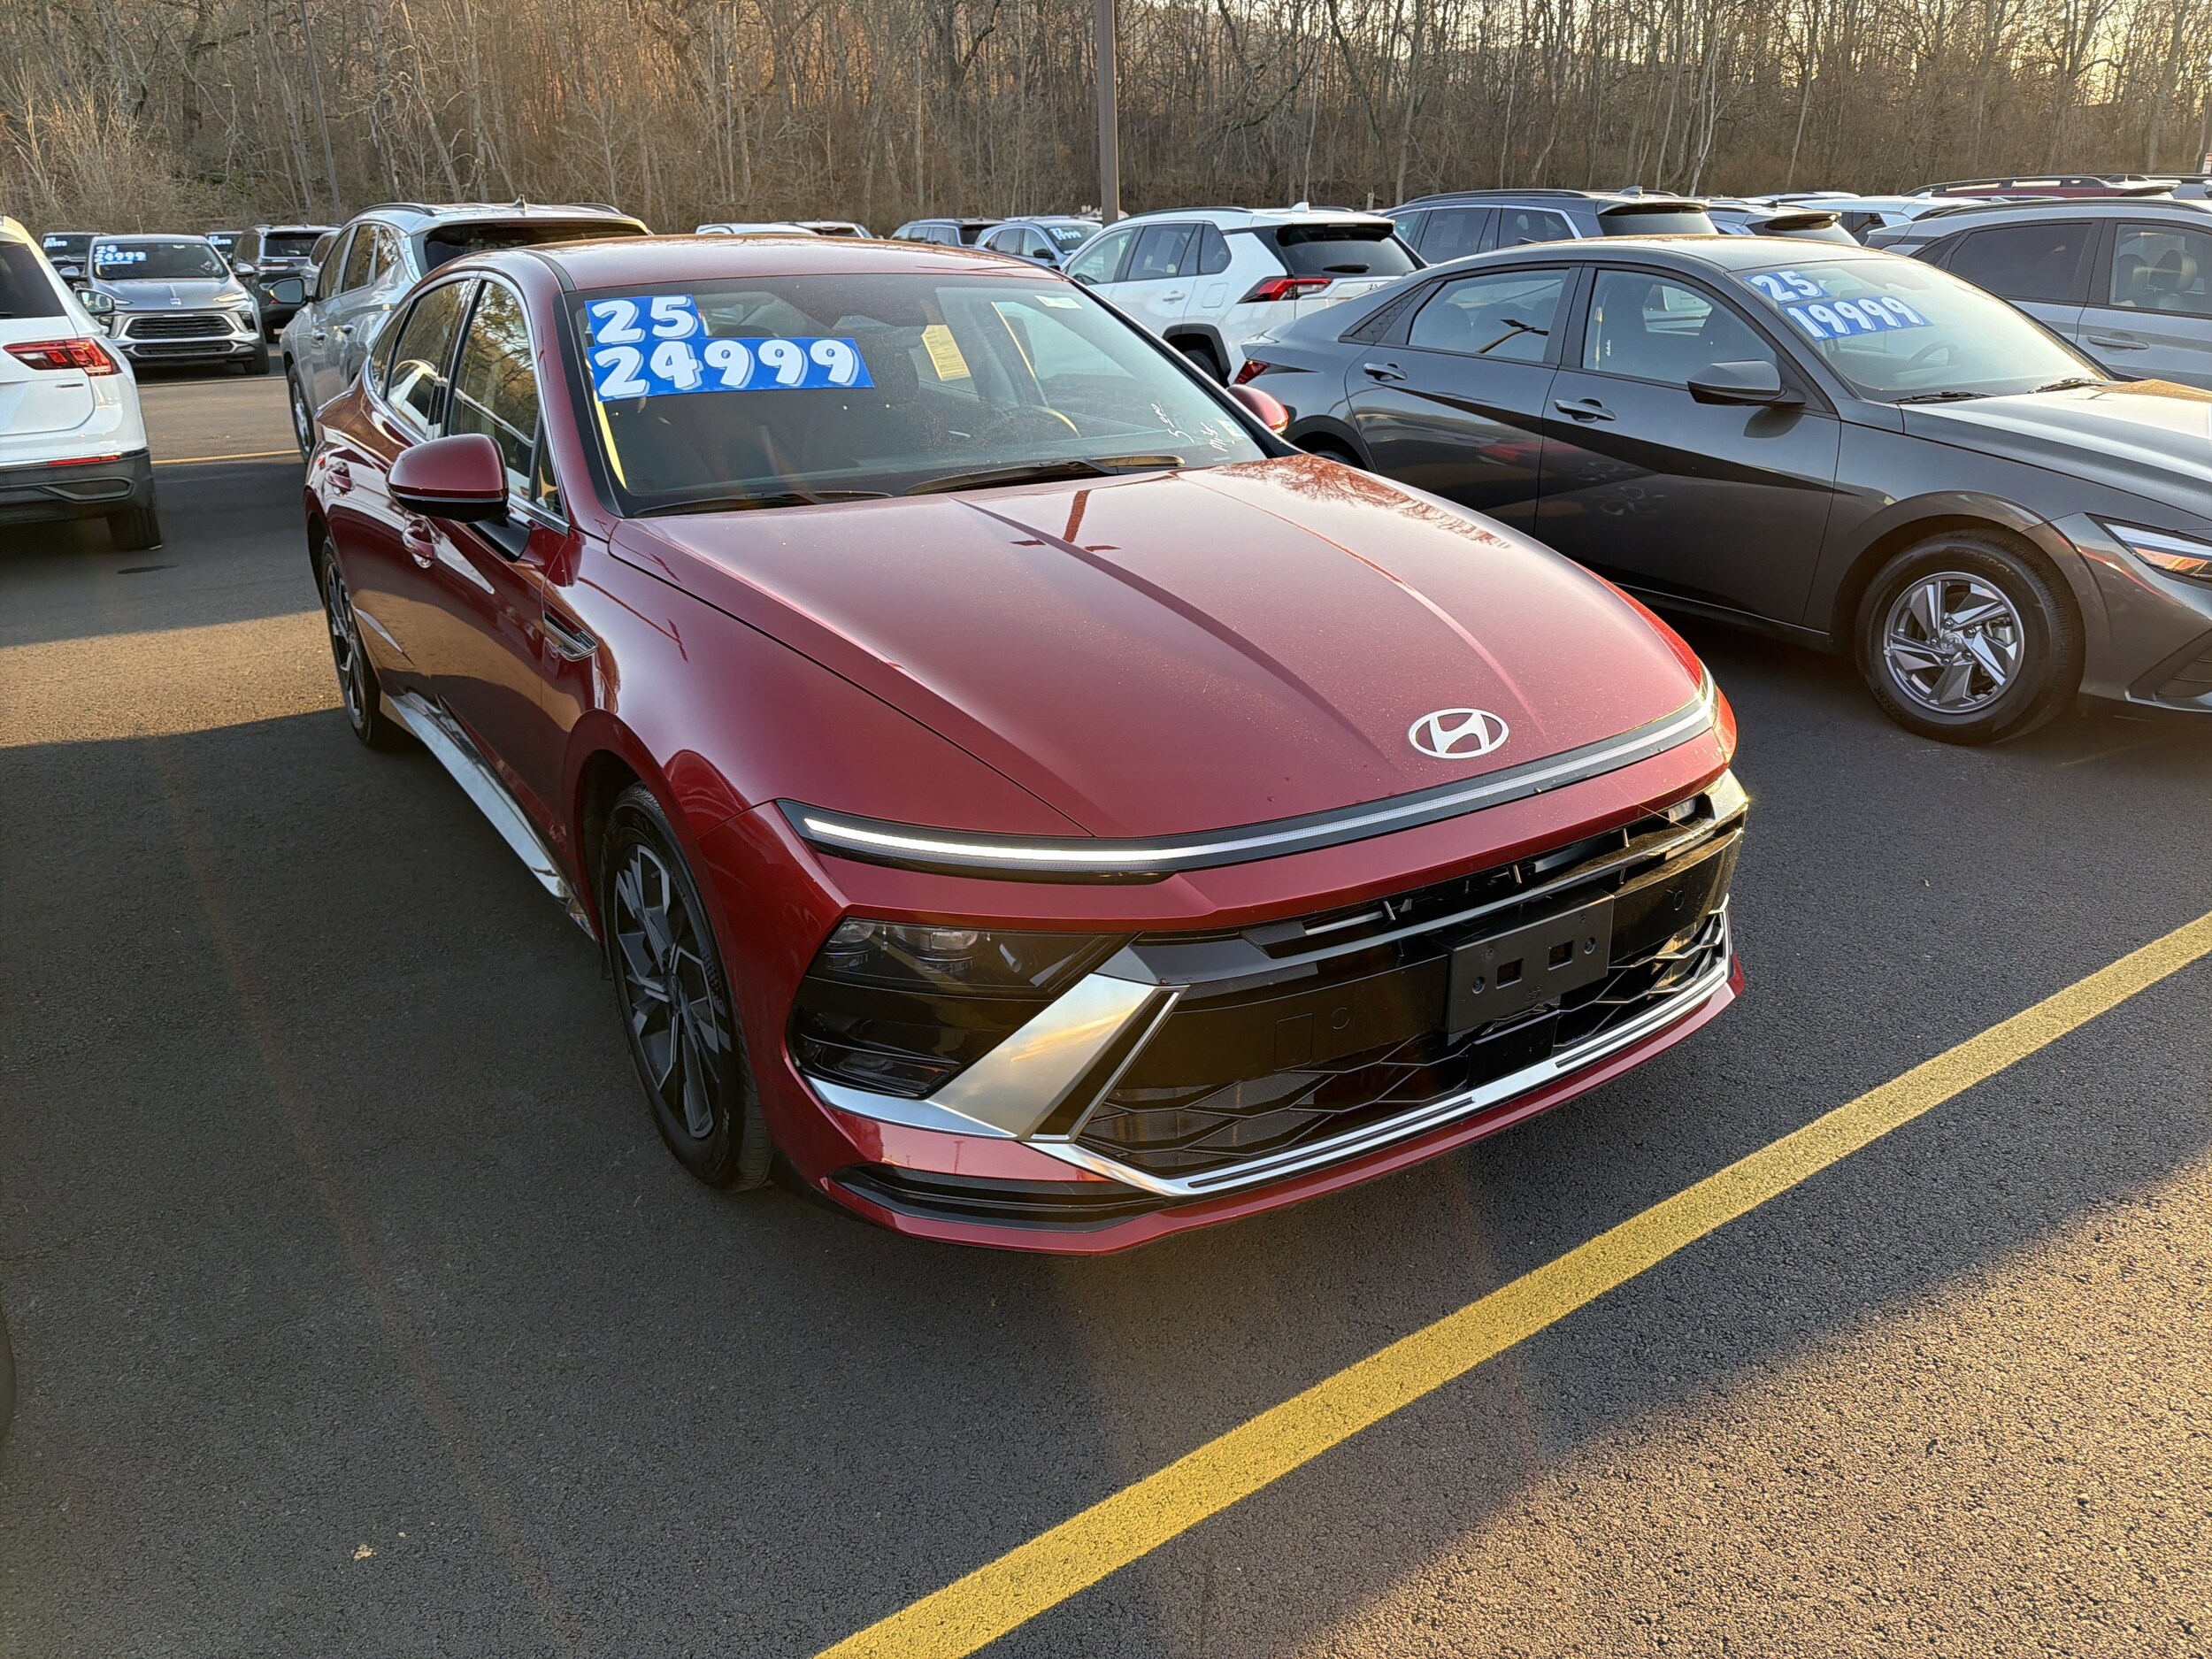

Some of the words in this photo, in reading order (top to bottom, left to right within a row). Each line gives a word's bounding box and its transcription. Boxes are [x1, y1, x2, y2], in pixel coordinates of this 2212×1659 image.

[1750, 271, 1823, 302] 25
[591, 296, 698, 344] 25
[1786, 296, 1924, 339] 19999
[594, 340, 859, 397] 24999
